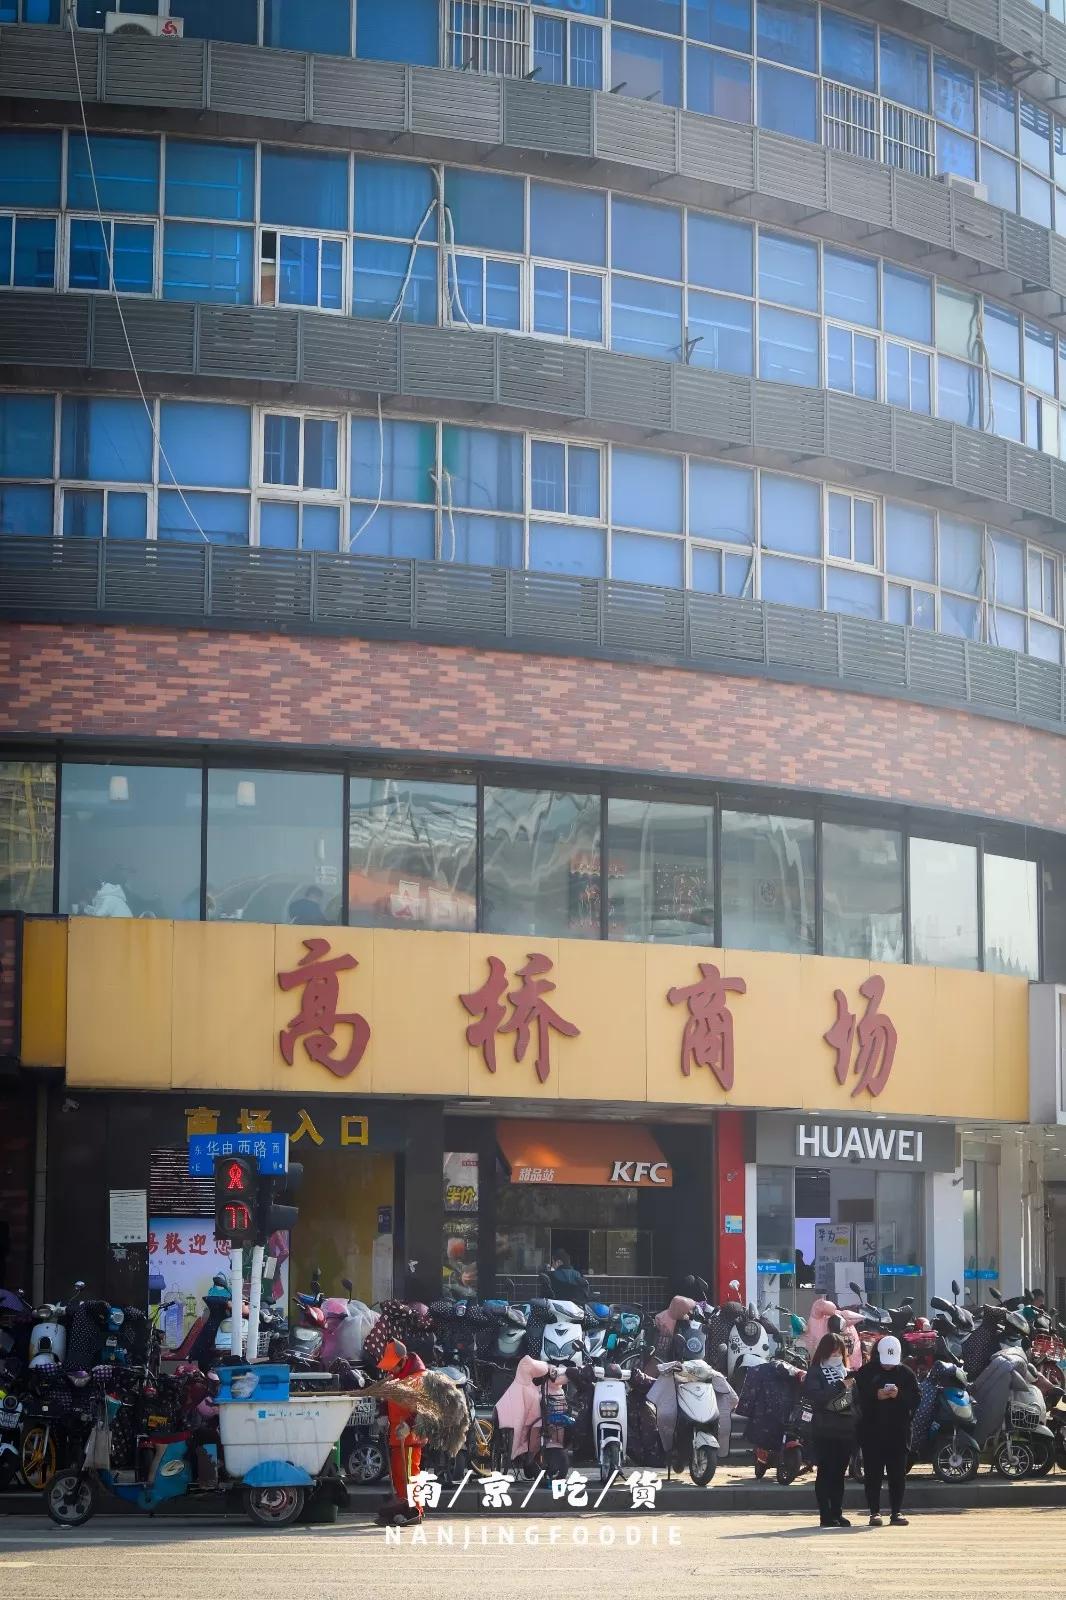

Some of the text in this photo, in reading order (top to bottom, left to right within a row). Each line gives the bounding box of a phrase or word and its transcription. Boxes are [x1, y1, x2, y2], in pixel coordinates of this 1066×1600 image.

[278, 938, 898, 1098] 高桥商场
[796, 1124, 923, 1162] HUAWEI
[518, 1168, 555, 1182] 甜品站
[610, 1161, 668, 1183] KFC
